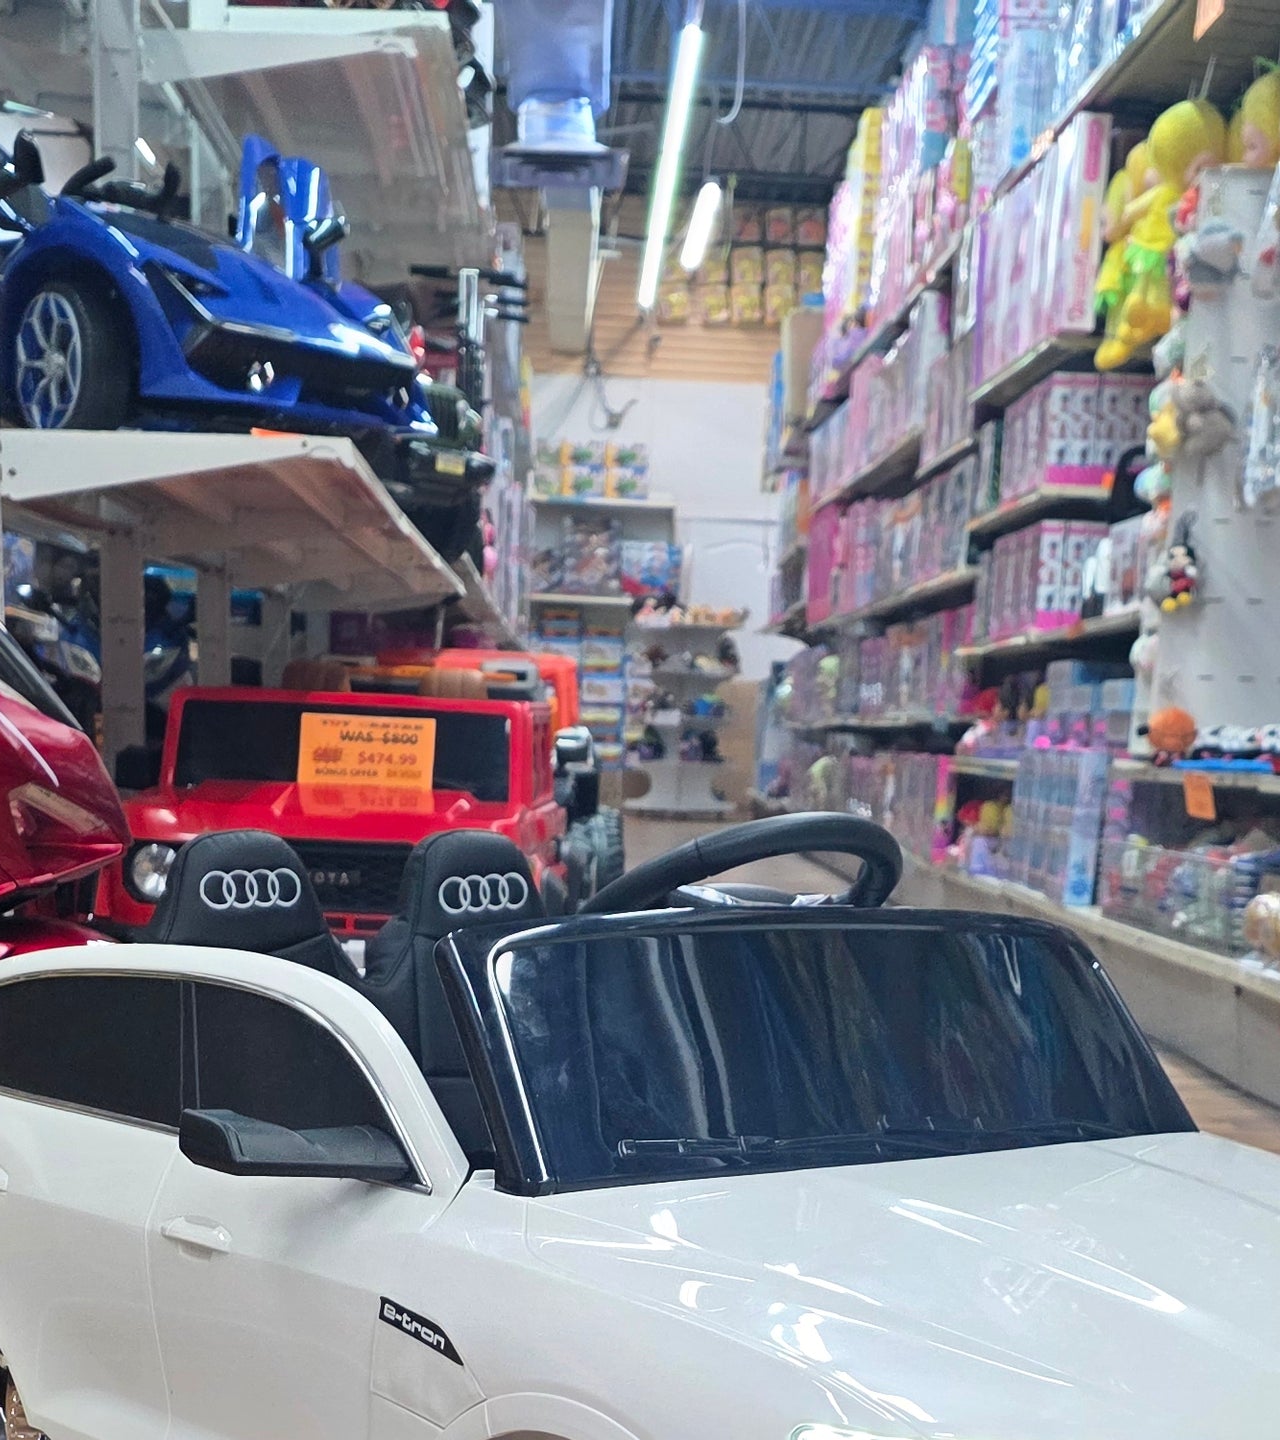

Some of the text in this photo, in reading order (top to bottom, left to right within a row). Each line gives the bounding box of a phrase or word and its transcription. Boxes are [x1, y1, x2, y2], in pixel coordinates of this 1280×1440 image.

[339, 730, 419, 745] WAS $800
[357, 751, 418, 766] $474.99
[383, 1303, 445, 1350] e-tron
